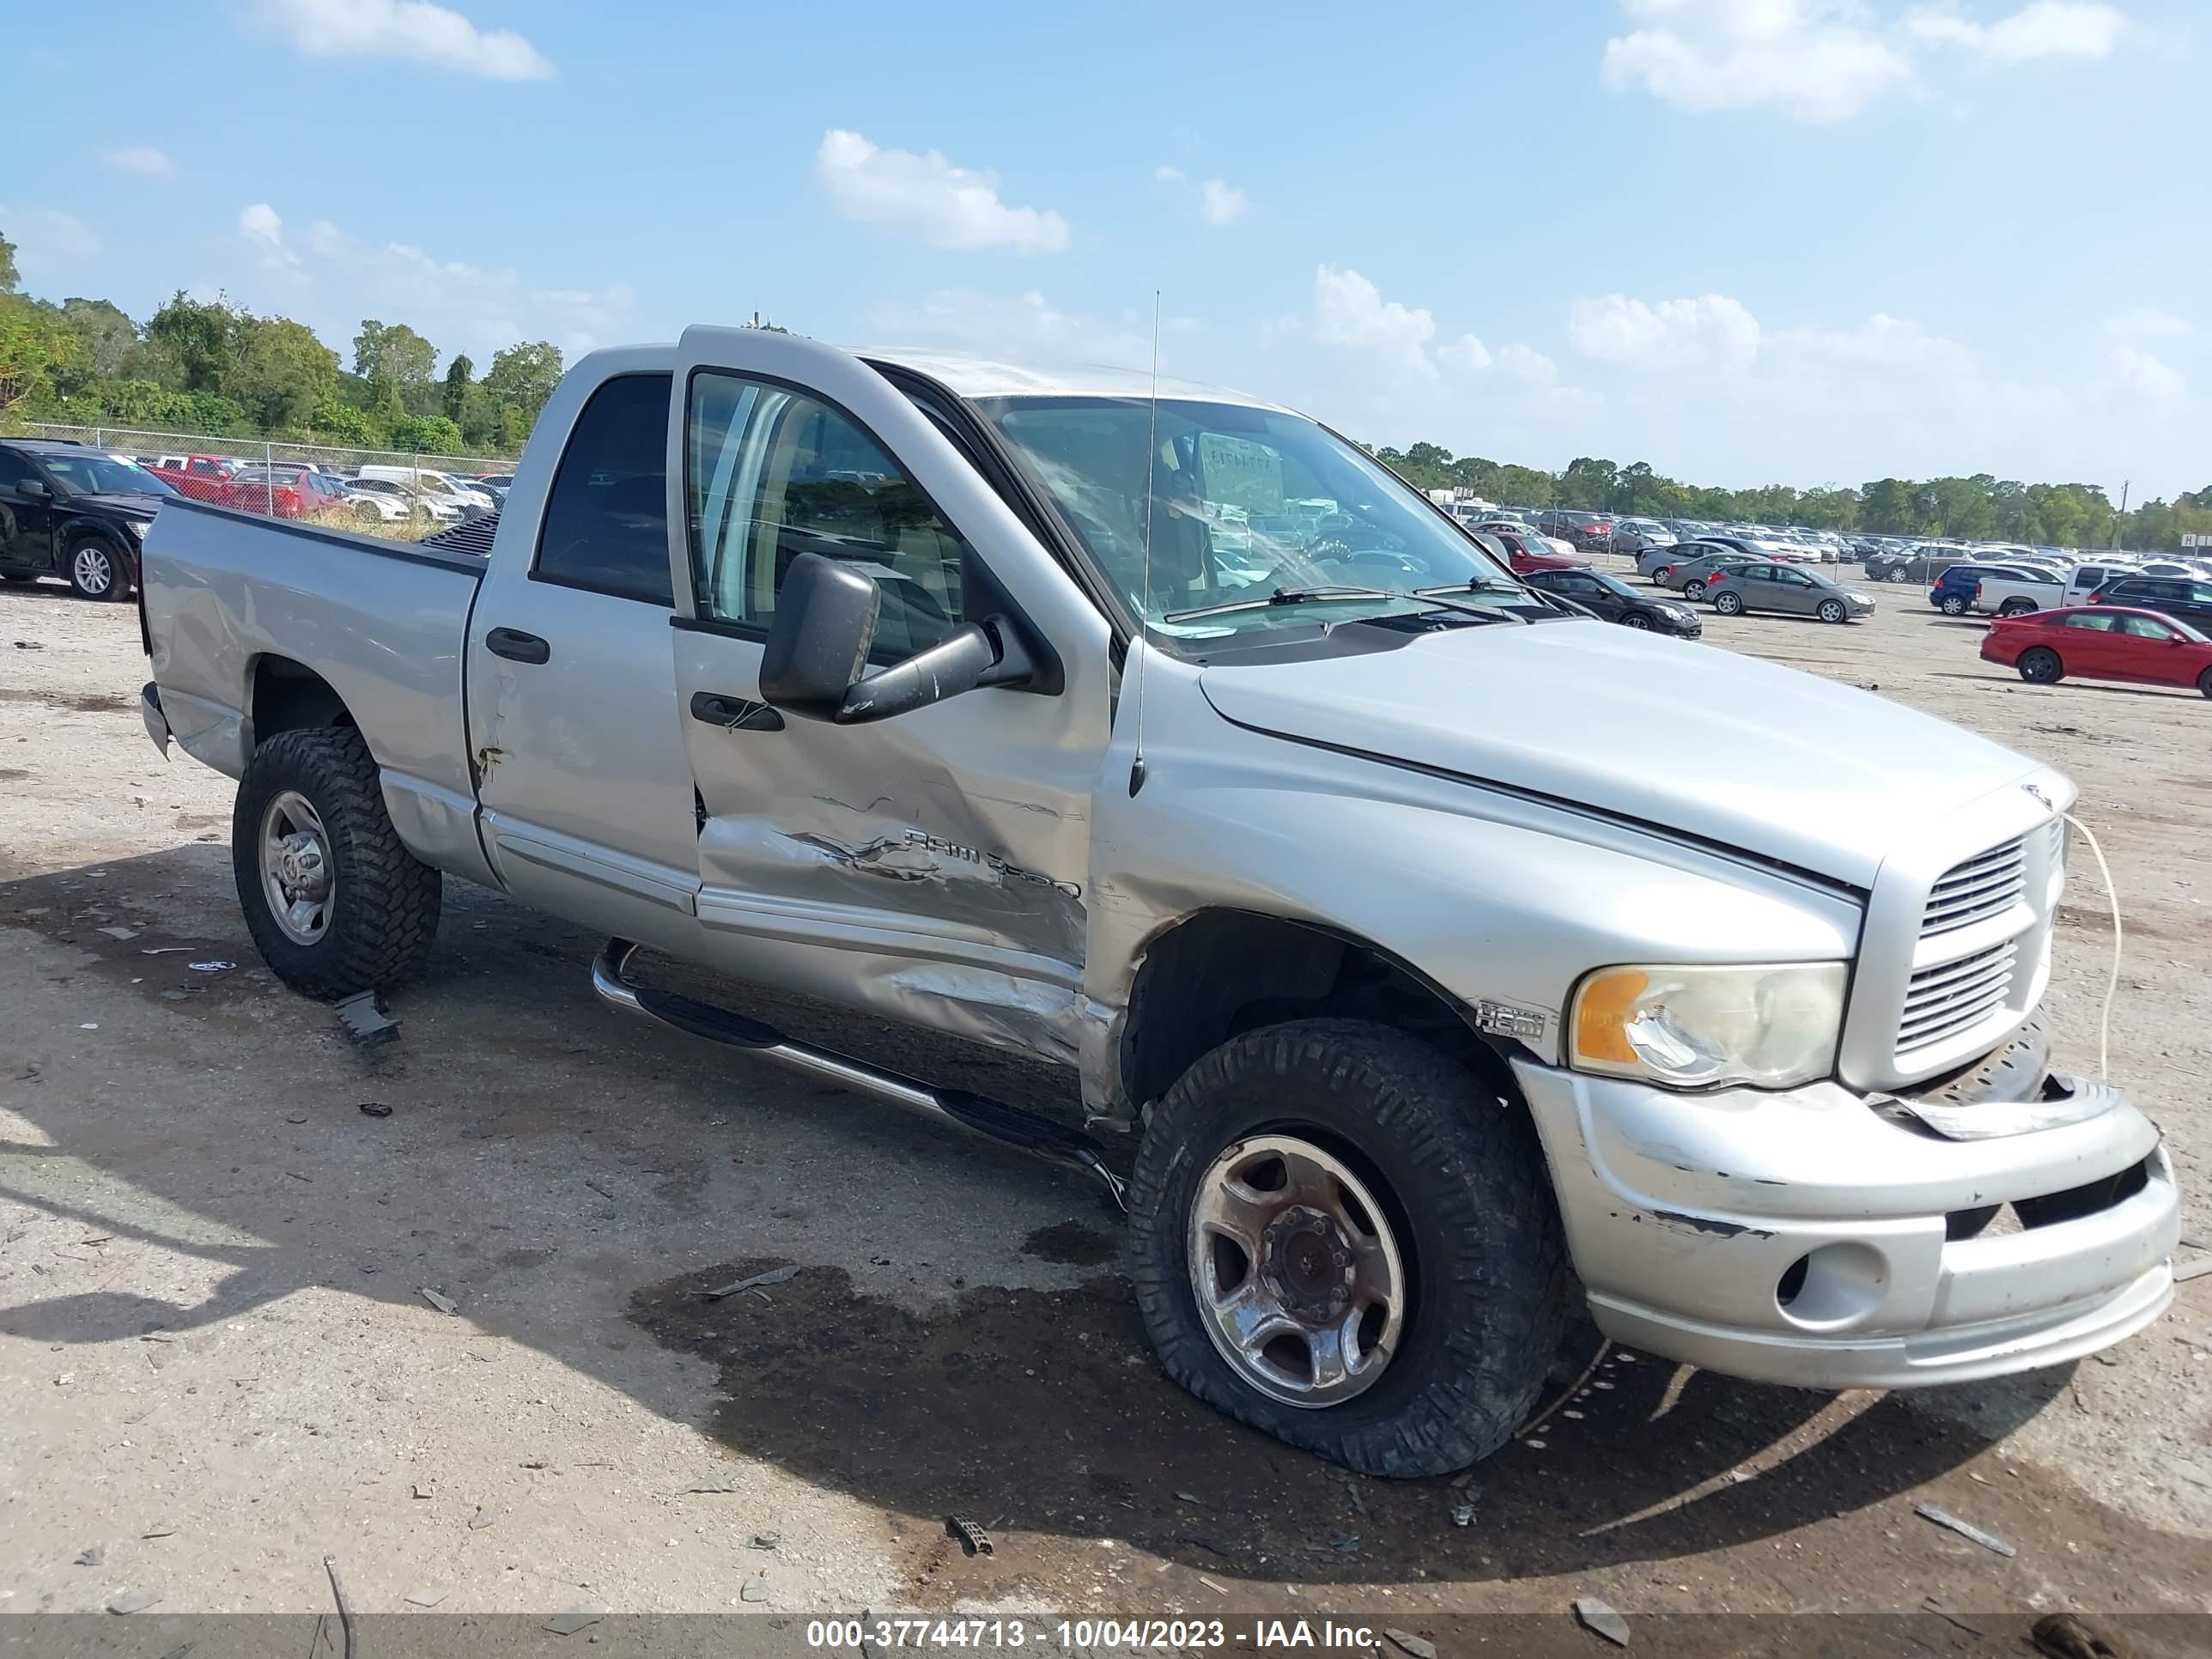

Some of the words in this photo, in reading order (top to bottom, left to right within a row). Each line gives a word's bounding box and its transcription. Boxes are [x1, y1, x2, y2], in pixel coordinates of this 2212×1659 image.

[2185, 535, 2192, 545] H
[904, 827, 981, 865] RAM
[1475, 1007, 1544, 1036] HEMI
